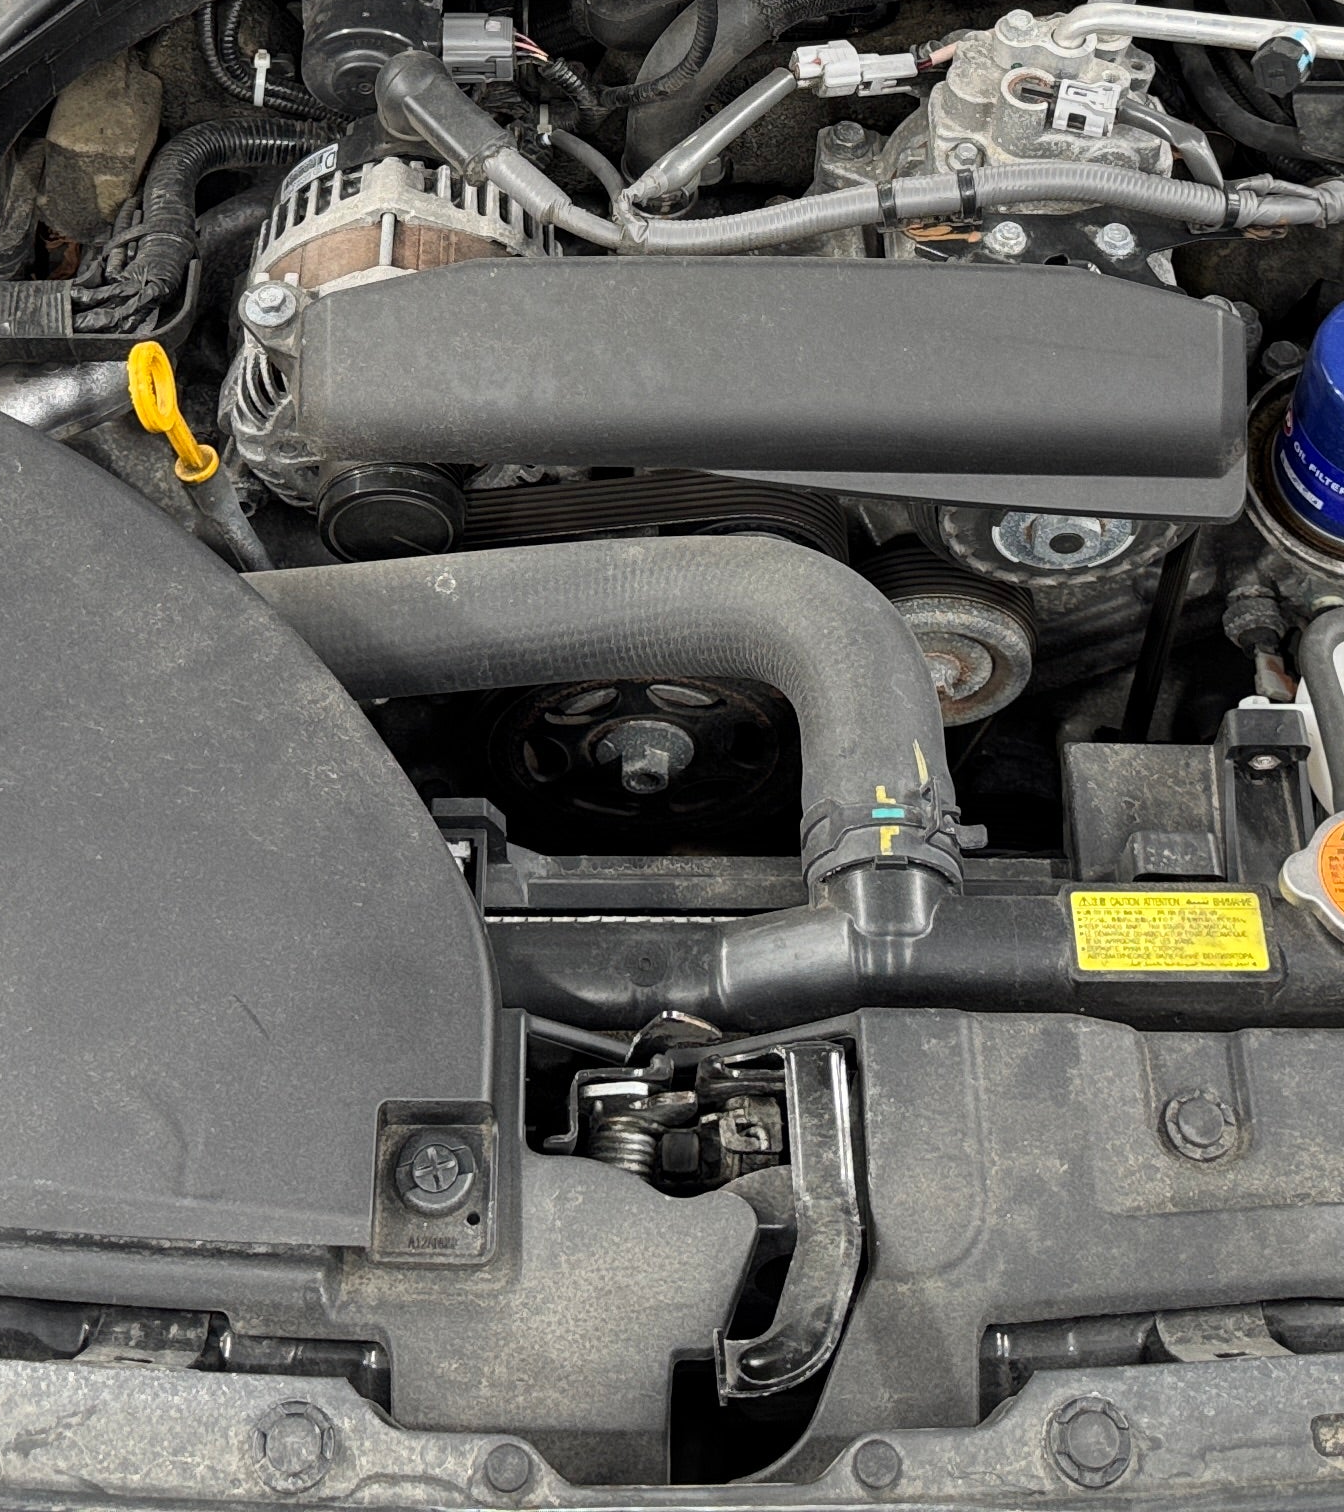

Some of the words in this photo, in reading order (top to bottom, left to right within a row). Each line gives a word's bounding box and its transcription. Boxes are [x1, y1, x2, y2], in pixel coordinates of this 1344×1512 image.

[1293, 441, 1307, 464] OIL
[1109, 897, 1140, 907] CAUTION
[1144, 897, 1180, 907] ATTENTION
